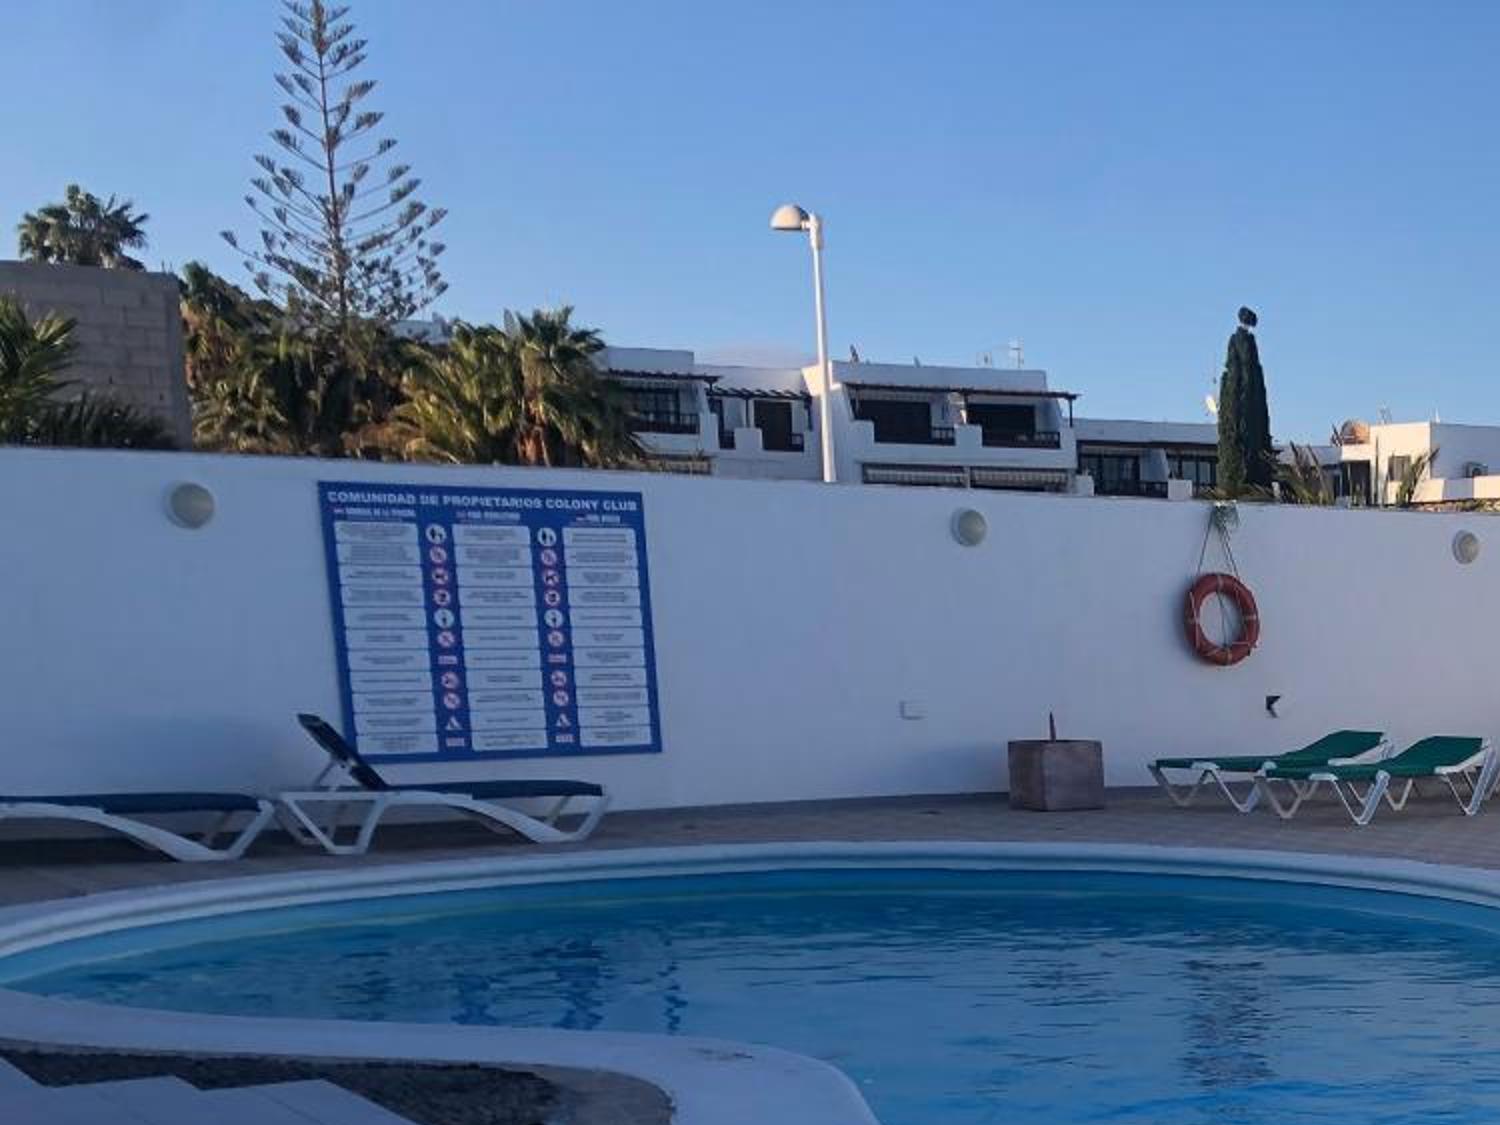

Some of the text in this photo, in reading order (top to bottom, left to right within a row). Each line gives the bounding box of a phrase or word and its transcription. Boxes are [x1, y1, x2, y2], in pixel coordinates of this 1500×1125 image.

[327, 491, 638, 512] COMUNIDAD DE PROPIETARIOS COLONY CLUB
